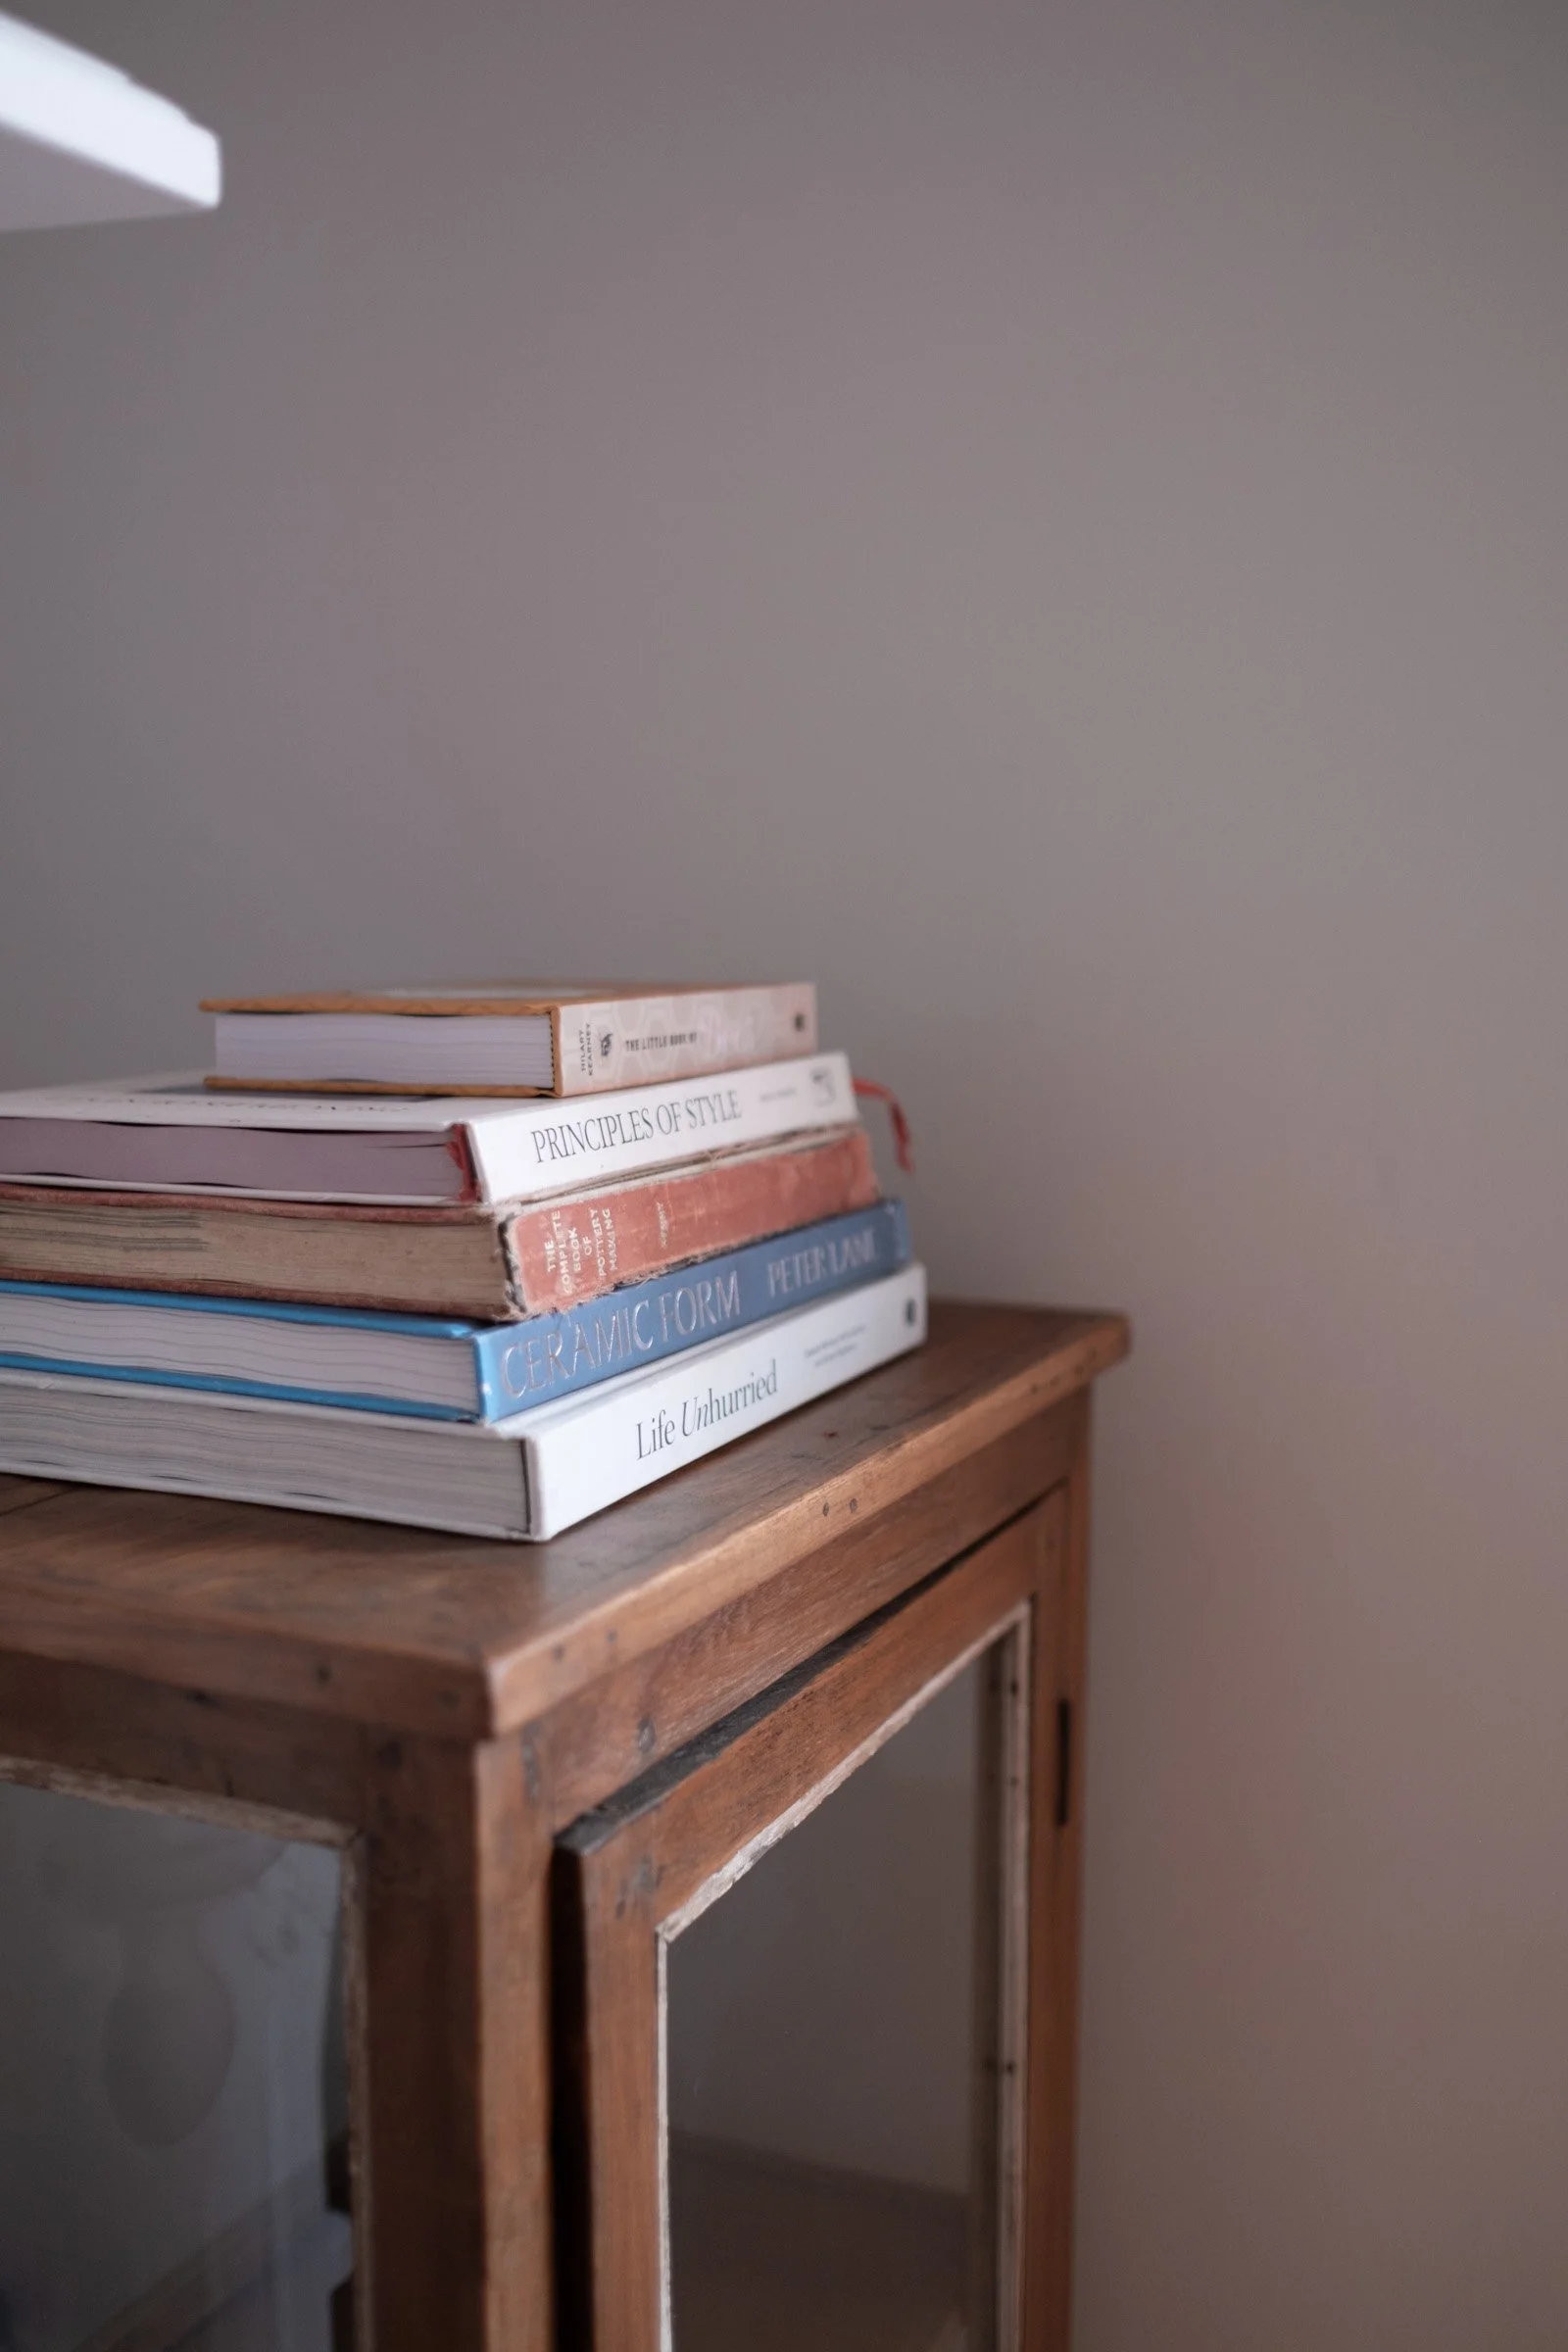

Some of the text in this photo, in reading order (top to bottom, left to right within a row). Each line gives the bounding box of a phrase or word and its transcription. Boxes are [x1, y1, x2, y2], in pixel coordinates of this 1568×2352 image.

[625, 1038, 640, 1052] THE
[642, 1035, 667, 1051] LITTLE
[530, 1090, 743, 1164] PRINCIPLES OF STYLE
[544, 1239, 556, 1272] THE
[552, 1210, 572, 1296] COMPLETE
[568, 1227, 581, 1272] BOOK
[582, 1236, 592, 1256] OF
[590, 1209, 607, 1278] POTTERY
[500, 1299, 654, 1399] CERAMIC
[660, 1270, 742, 1343] FORM
[767, 1245, 826, 1298] PETER
[636, 1357, 779, 1460] Life Unhurried
